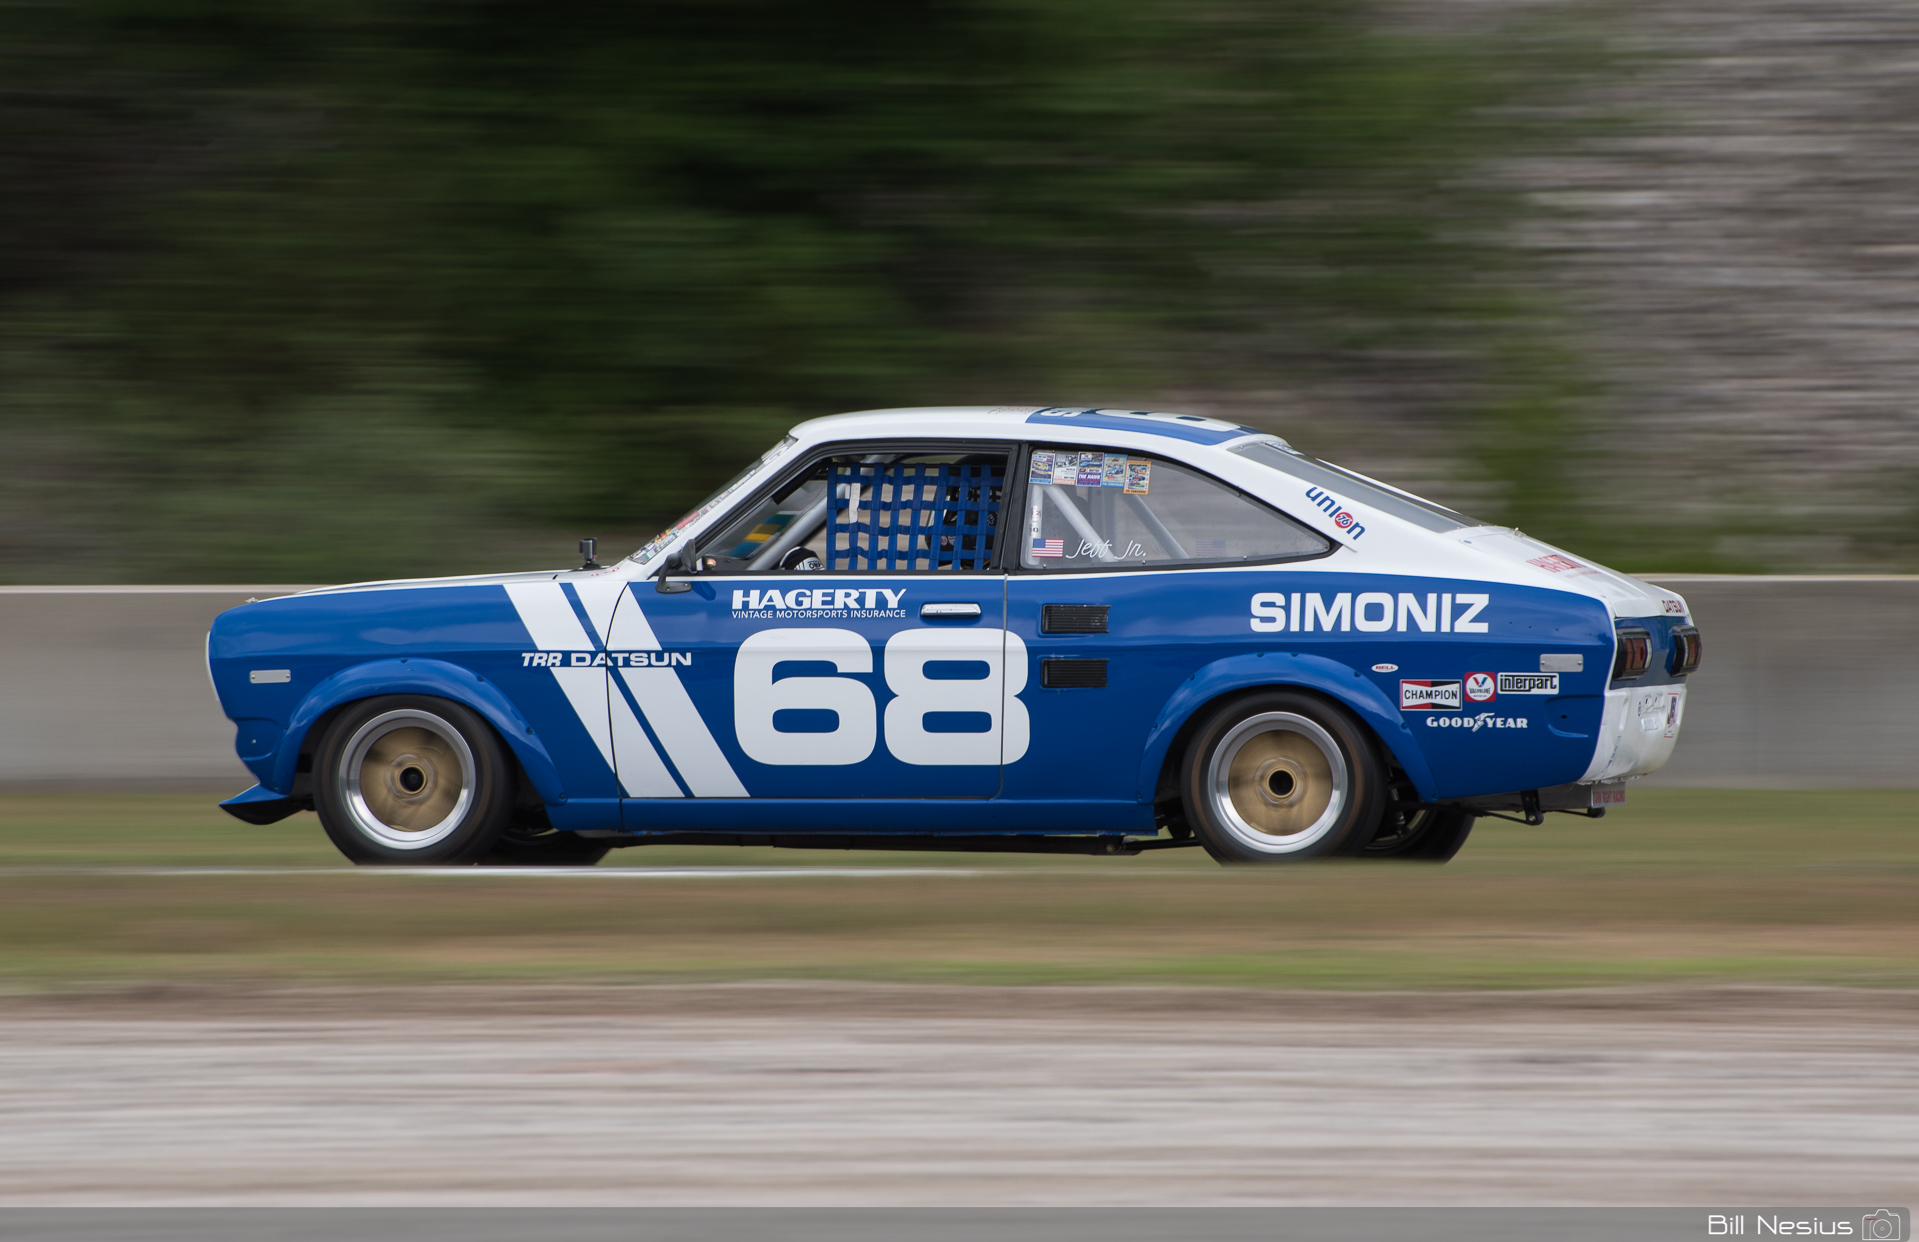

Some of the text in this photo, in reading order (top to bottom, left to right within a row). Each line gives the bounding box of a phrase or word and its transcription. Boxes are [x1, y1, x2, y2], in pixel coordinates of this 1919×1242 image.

[1065, 539, 1147, 560] Jeff Jr.
[732, 589, 907, 610] HAGERTY
[732, 609, 906, 618] VINTAGE MOTORSPORTS INSURANCE
[1250, 592, 1490, 633] SIMONIZ
[521, 652, 692, 667] TRR DATSUN
[1500, 674, 1557, 692] interpart
[734, 627, 1031, 766] 68
[1404, 689, 1458, 700] CHAMPION
